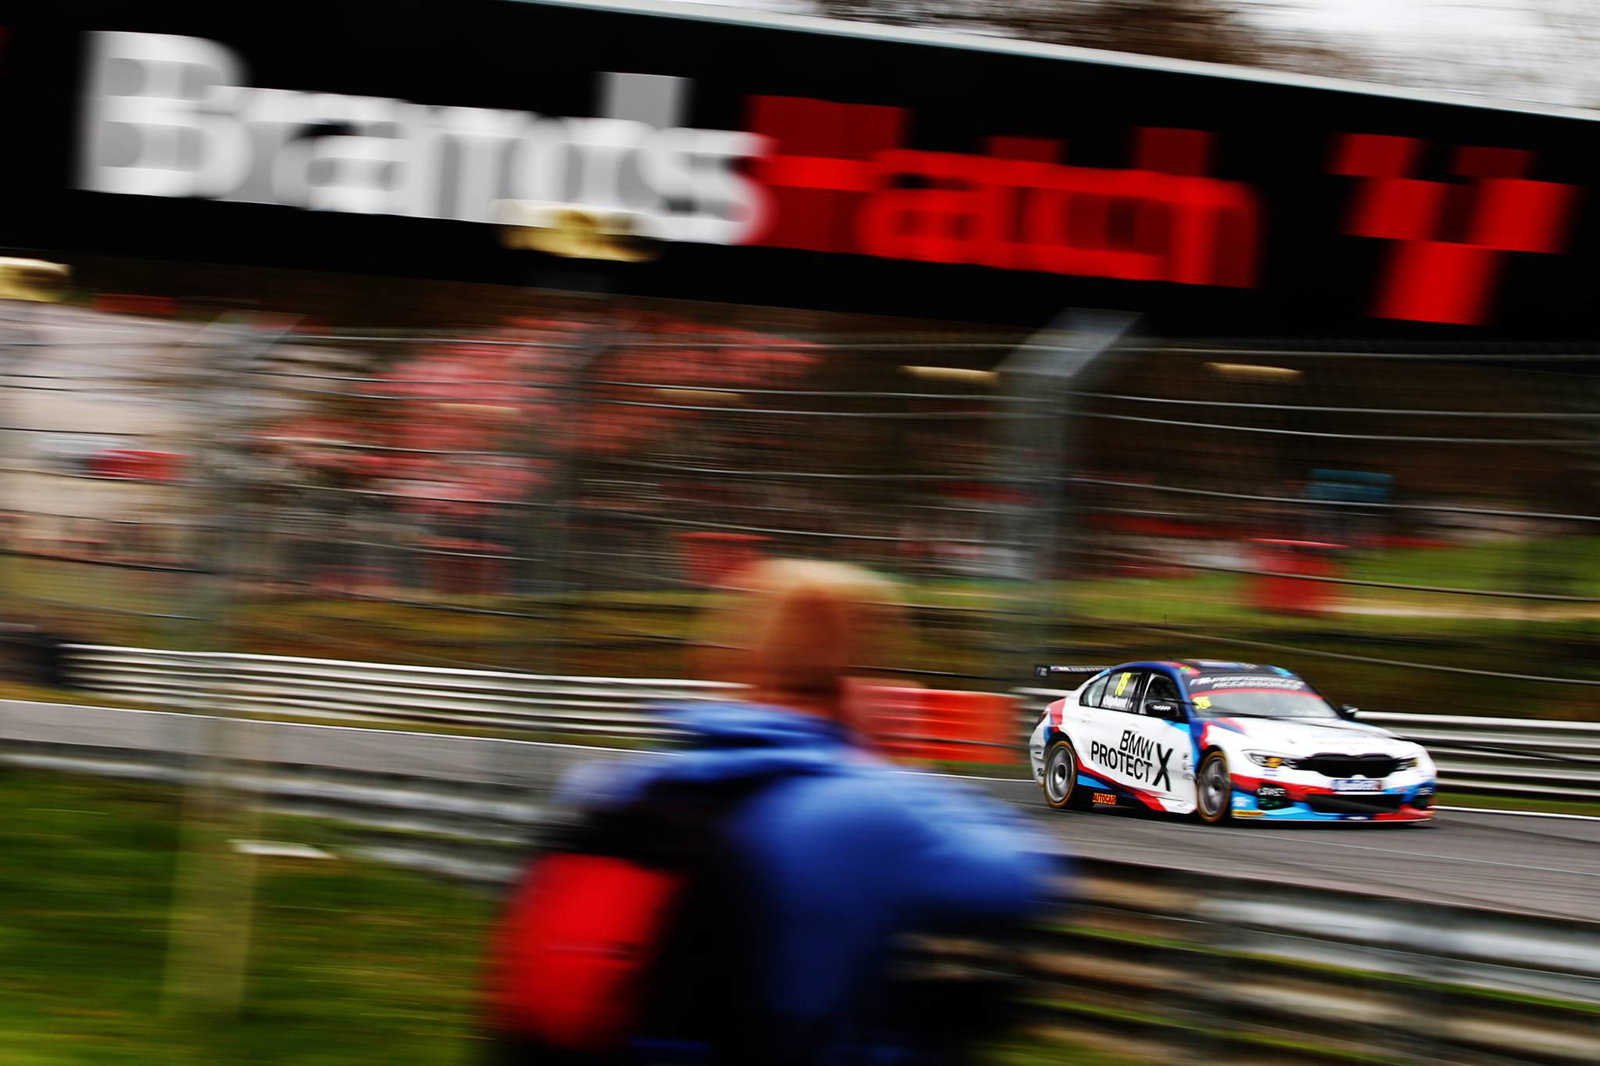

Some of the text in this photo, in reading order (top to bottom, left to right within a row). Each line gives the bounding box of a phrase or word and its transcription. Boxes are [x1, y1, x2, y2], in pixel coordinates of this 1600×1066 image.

[80, 30, 764, 245] Brands
[1091, 740, 1174, 792] PROTECT X
[1119, 729, 1154, 761] BMW
[1092, 793, 1116, 805] AUTOCAR
